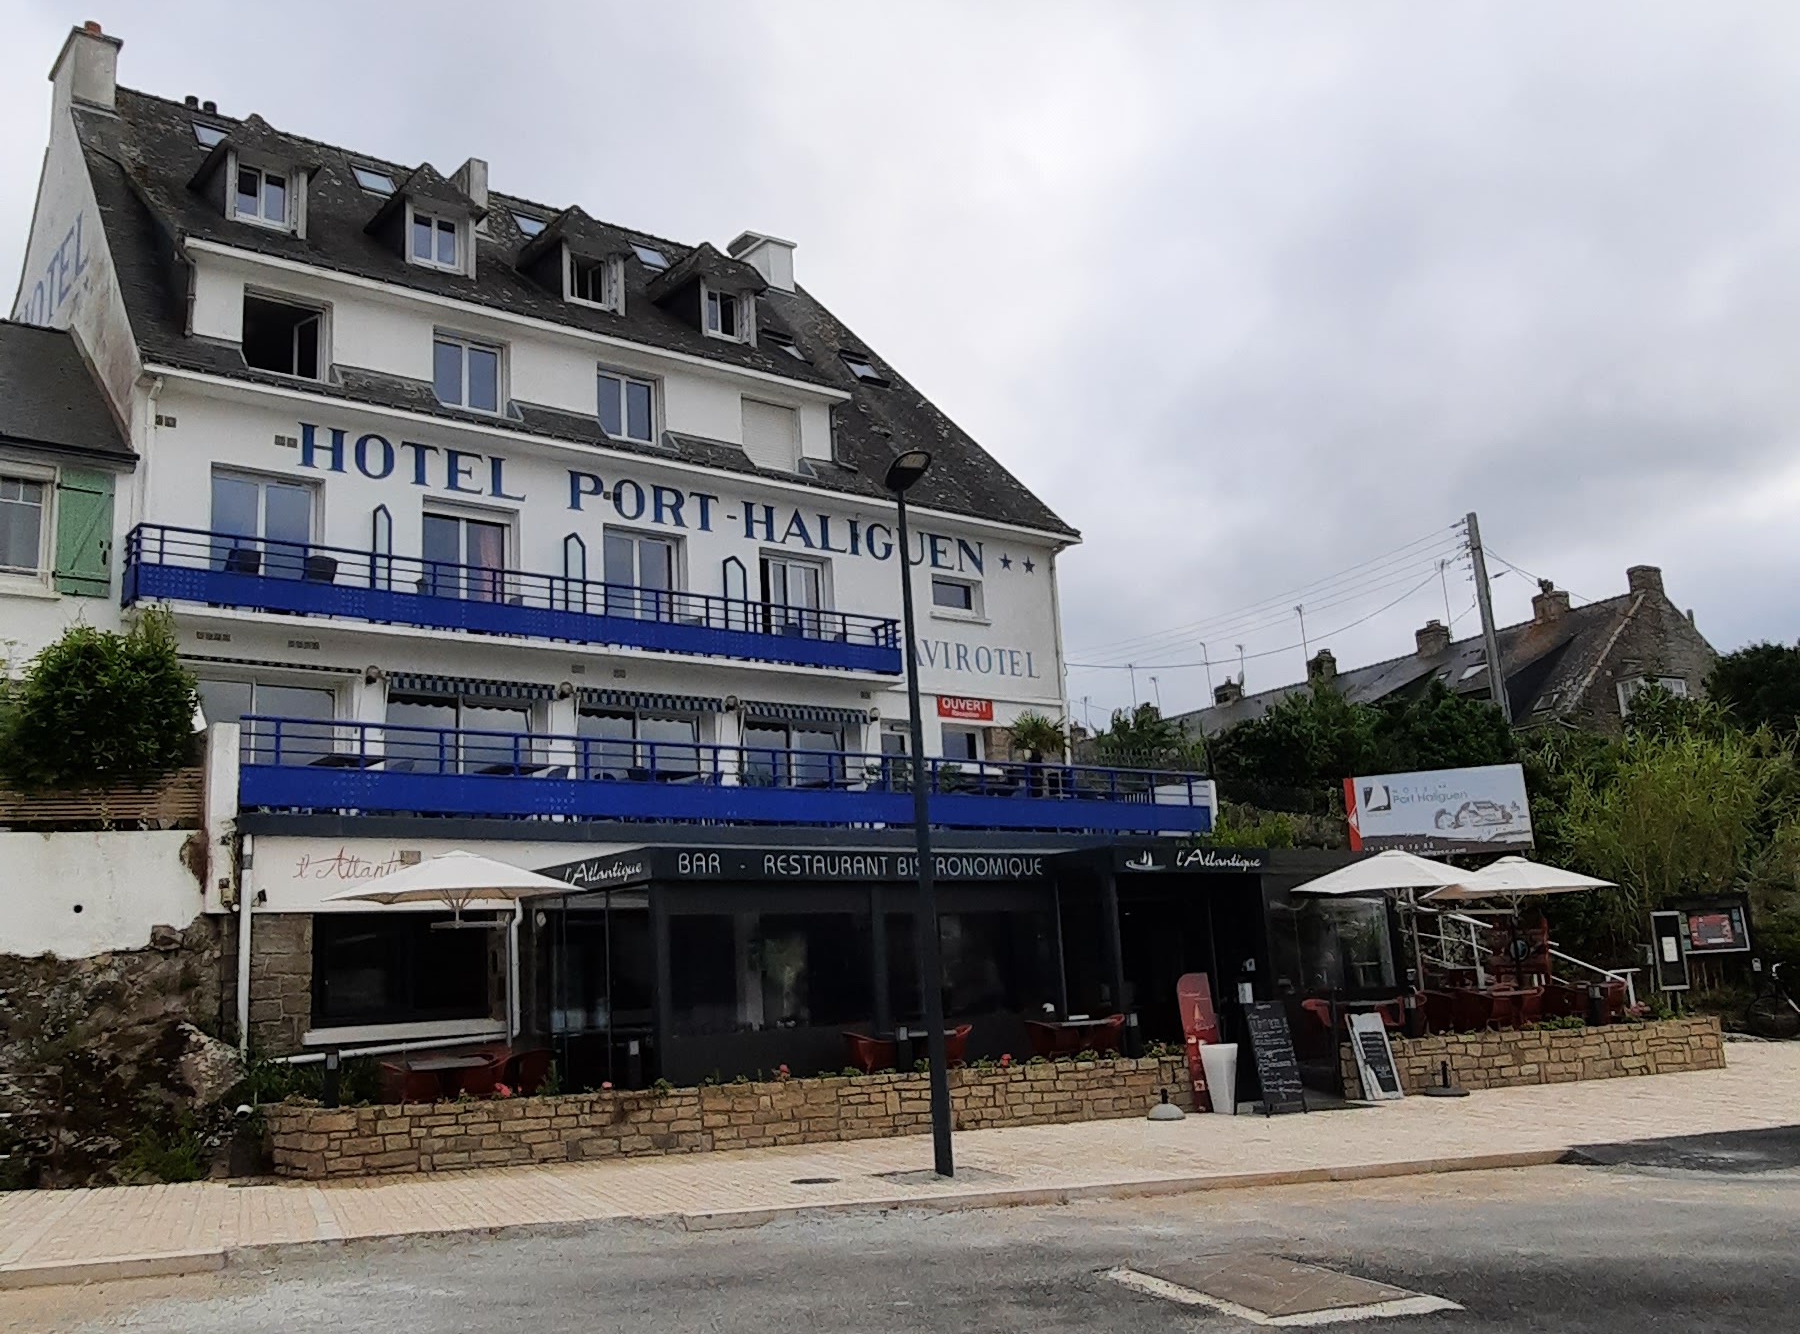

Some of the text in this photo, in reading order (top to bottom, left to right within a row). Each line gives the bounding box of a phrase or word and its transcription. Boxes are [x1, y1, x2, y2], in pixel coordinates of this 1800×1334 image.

[16, 210, 91, 324] OTEL
[297, 421, 526, 502] HOTEL
[942, 697, 988, 712] OUVERT
[678, 852, 721, 874] BAR
[764, 854, 888, 876] RESTAURANT
[897, 856, 1043, 879] BIRONOMIQUE
[1176, 848, 1261, 872] l'Atlantique
